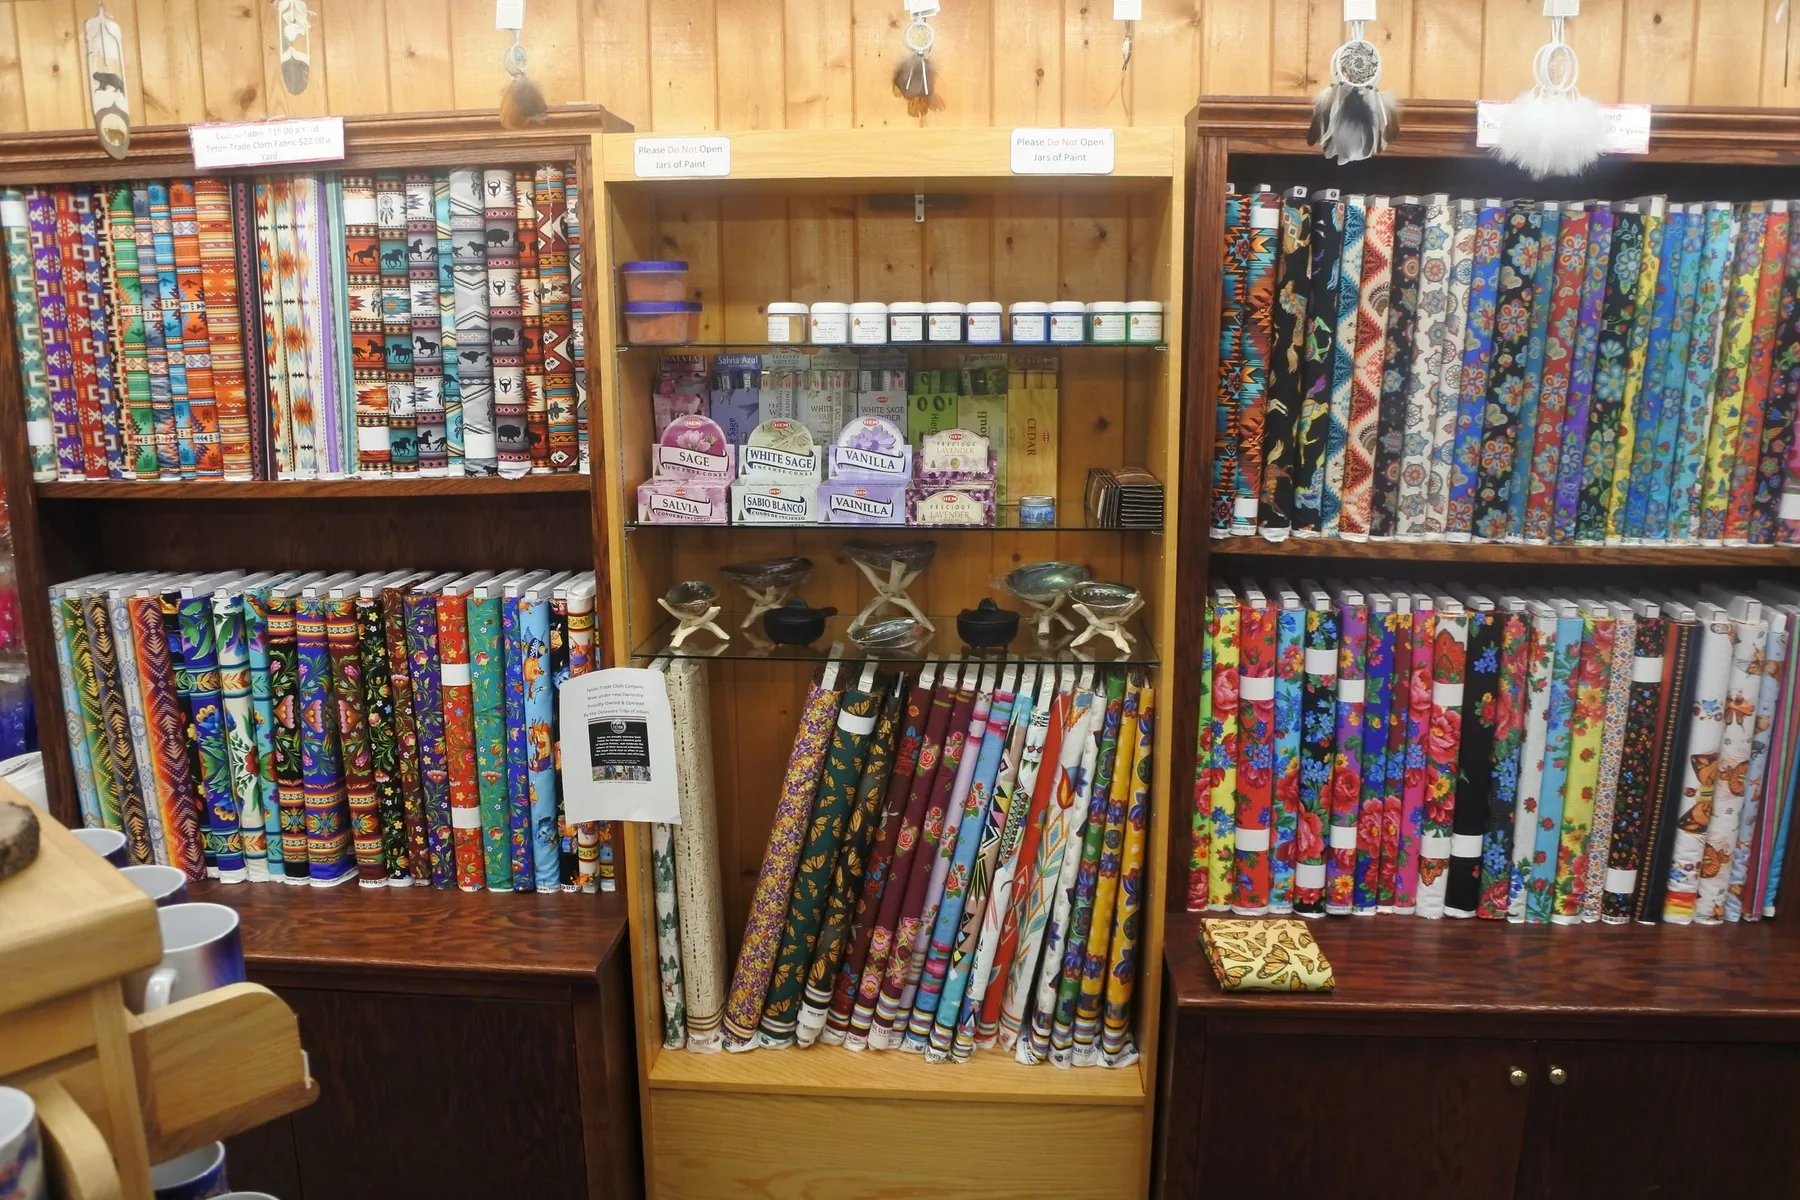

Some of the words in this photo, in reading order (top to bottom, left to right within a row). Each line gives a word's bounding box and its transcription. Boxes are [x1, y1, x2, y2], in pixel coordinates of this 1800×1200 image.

[206, 144, 228, 153] Teton
[230, 142, 251, 151] Trade
[252, 140, 273, 150] Cloth
[274, 138, 297, 149] Fabric
[638, 145, 666, 155] Please
[668, 145, 680, 154] Do
[681, 145, 697, 154] Not
[699, 144, 723, 154] Open
[1016, 137, 1045, 147] Please
[1047, 138, 1059, 147] Do
[1062, 138, 1078, 147] Not
[1080, 137, 1104, 148] Open
[655, 160, 672, 169] Jars
[673, 159, 682, 169] of
[684, 160, 706, 169] Paint
[1033, 153, 1051, 162] Jars
[1053, 152, 1062, 161] of
[1064, 153, 1087, 162] Paint
[718, 355, 740, 365] Salvia
[741, 354, 758, 364] Azul
[727, 417, 738, 437] Sage
[1027, 418, 1037, 456] CEDAR
[679, 451, 710, 467] SAGE
[750, 449, 783, 464] WHITE
[785, 455, 812, 469] SAGE
[845, 450, 895, 469] VANILLA
[666, 465, 700, 475] INCENSE
[754, 464, 786, 474] INCENSE
[662, 498, 699, 514] SALVIA
[747, 496, 771, 508] SABIO
[772, 501, 804, 514] BLANCO
[835, 497, 888, 515] VAINILLA
[930, 511, 970, 519] LAVENDER
